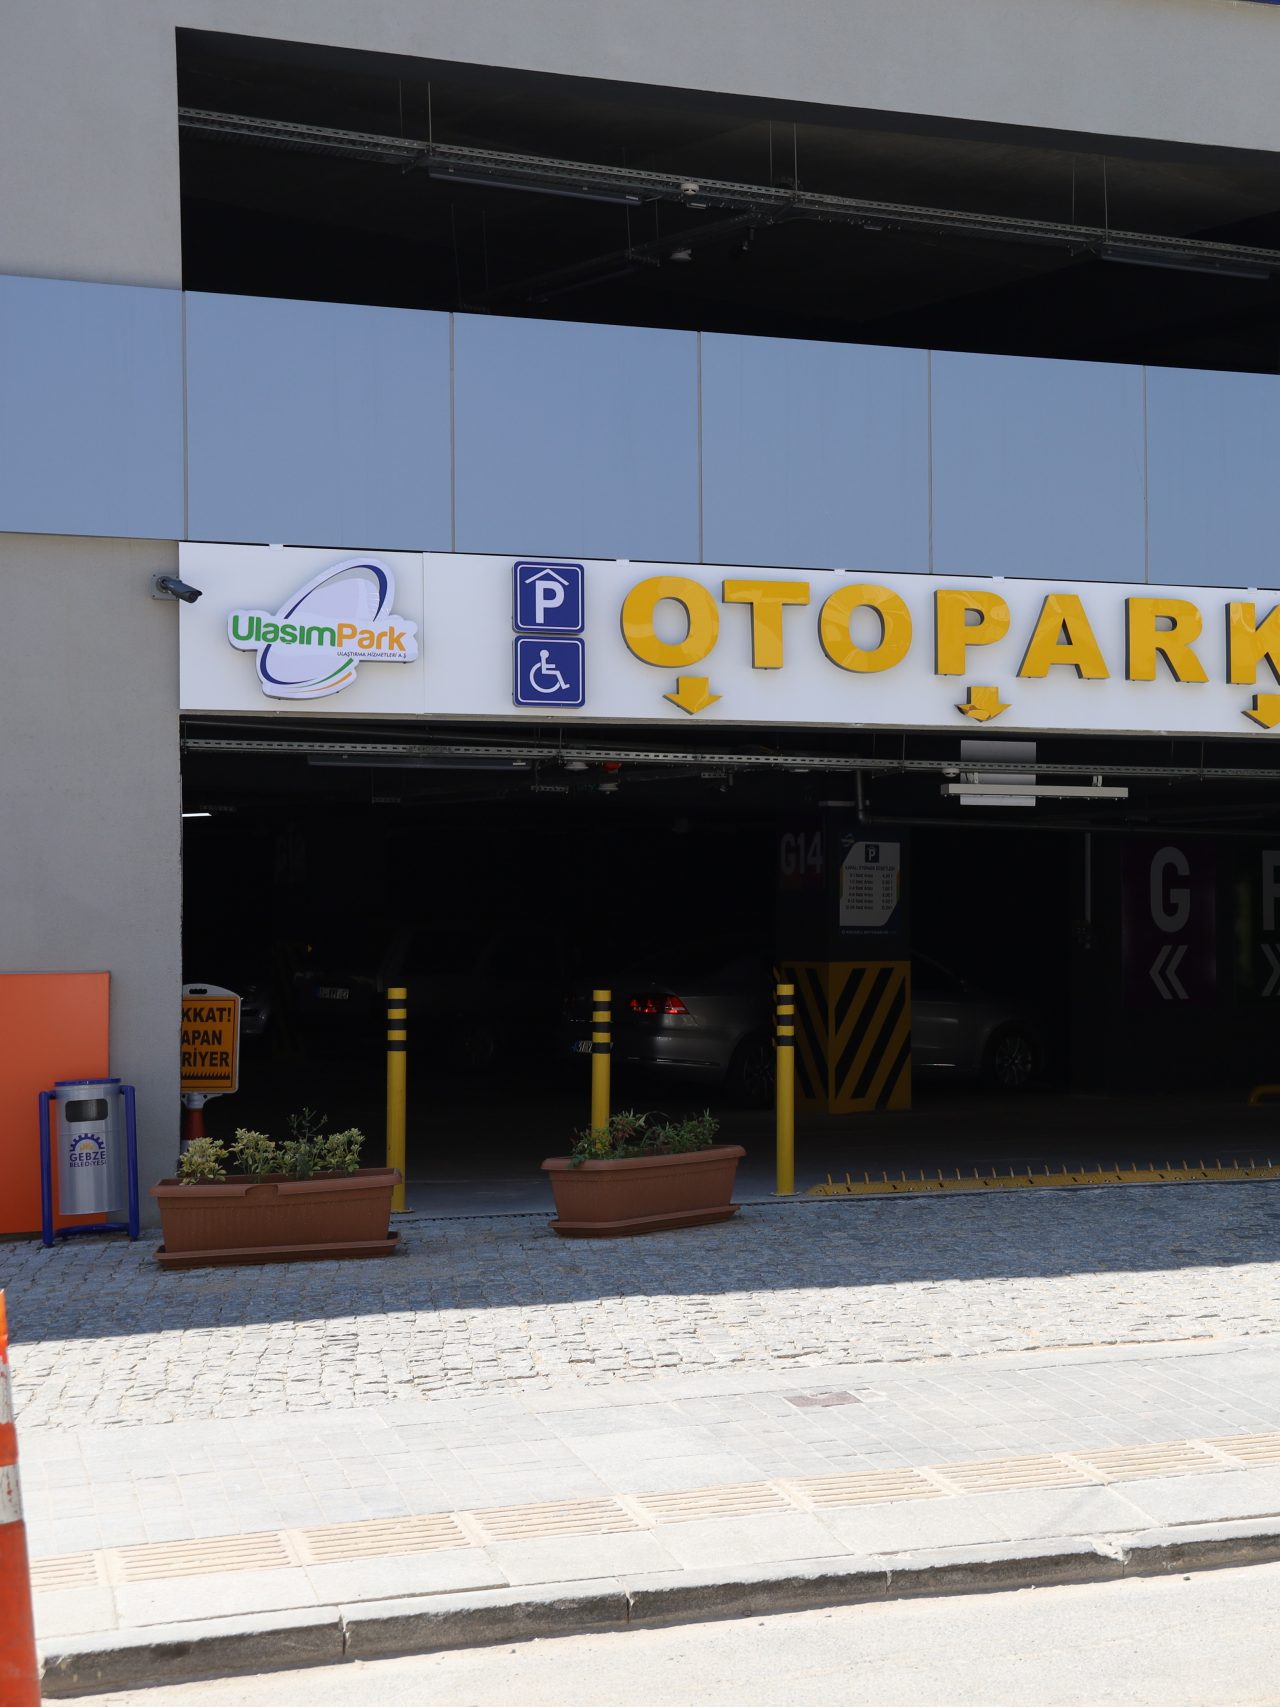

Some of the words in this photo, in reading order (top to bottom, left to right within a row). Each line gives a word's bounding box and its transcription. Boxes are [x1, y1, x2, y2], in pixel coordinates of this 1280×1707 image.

[535, 581, 565, 624] P
[779, 831, 824, 876] G14
[1149, 846, 1191, 933] G
[69, 1150, 106, 1162] GEBZE
